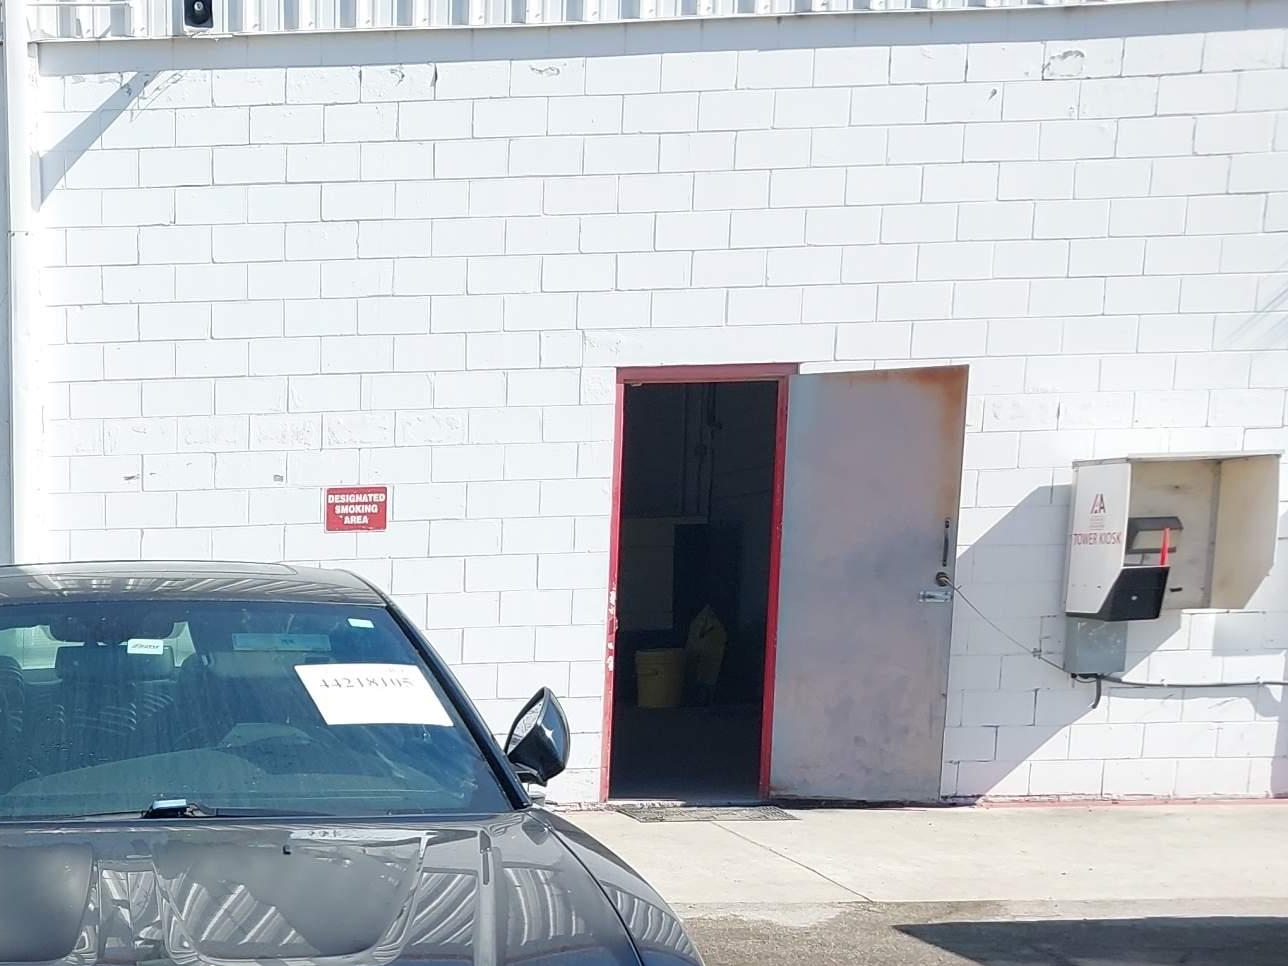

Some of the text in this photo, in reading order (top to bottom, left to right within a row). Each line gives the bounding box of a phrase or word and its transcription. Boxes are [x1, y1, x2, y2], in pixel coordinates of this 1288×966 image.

[327, 493, 385, 503] DESIGNATED
[335, 504, 378, 514] SMOKING
[344, 515, 369, 525] AREA
[1072, 532, 1121, 545] TOWER KIOSK
